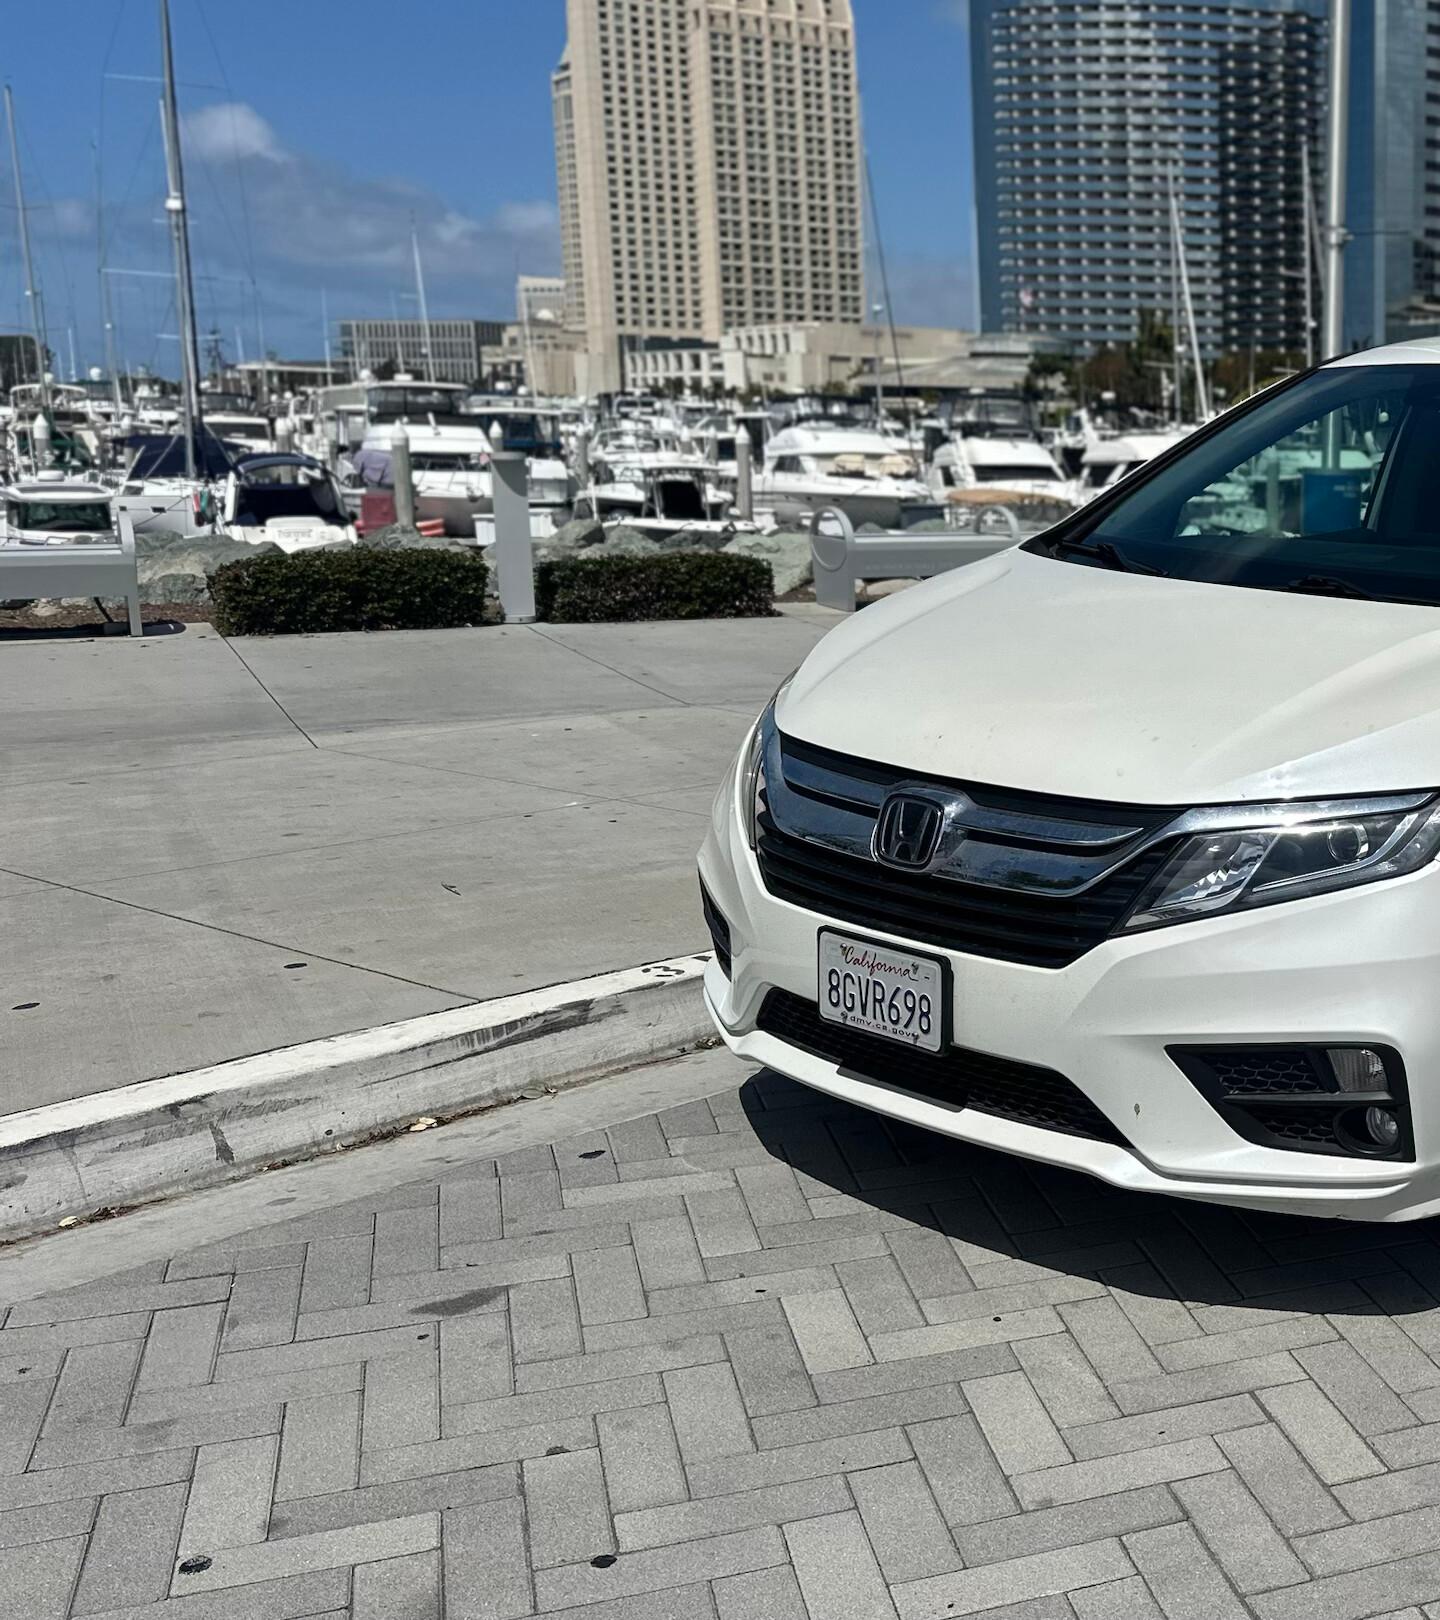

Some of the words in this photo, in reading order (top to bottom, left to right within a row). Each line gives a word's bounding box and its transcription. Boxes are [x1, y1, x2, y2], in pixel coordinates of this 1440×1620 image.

[844, 945, 918, 982] California
[828, 968, 931, 1034] 8GVR698
[850, 1015, 911, 1037] dmv.ca.gov
